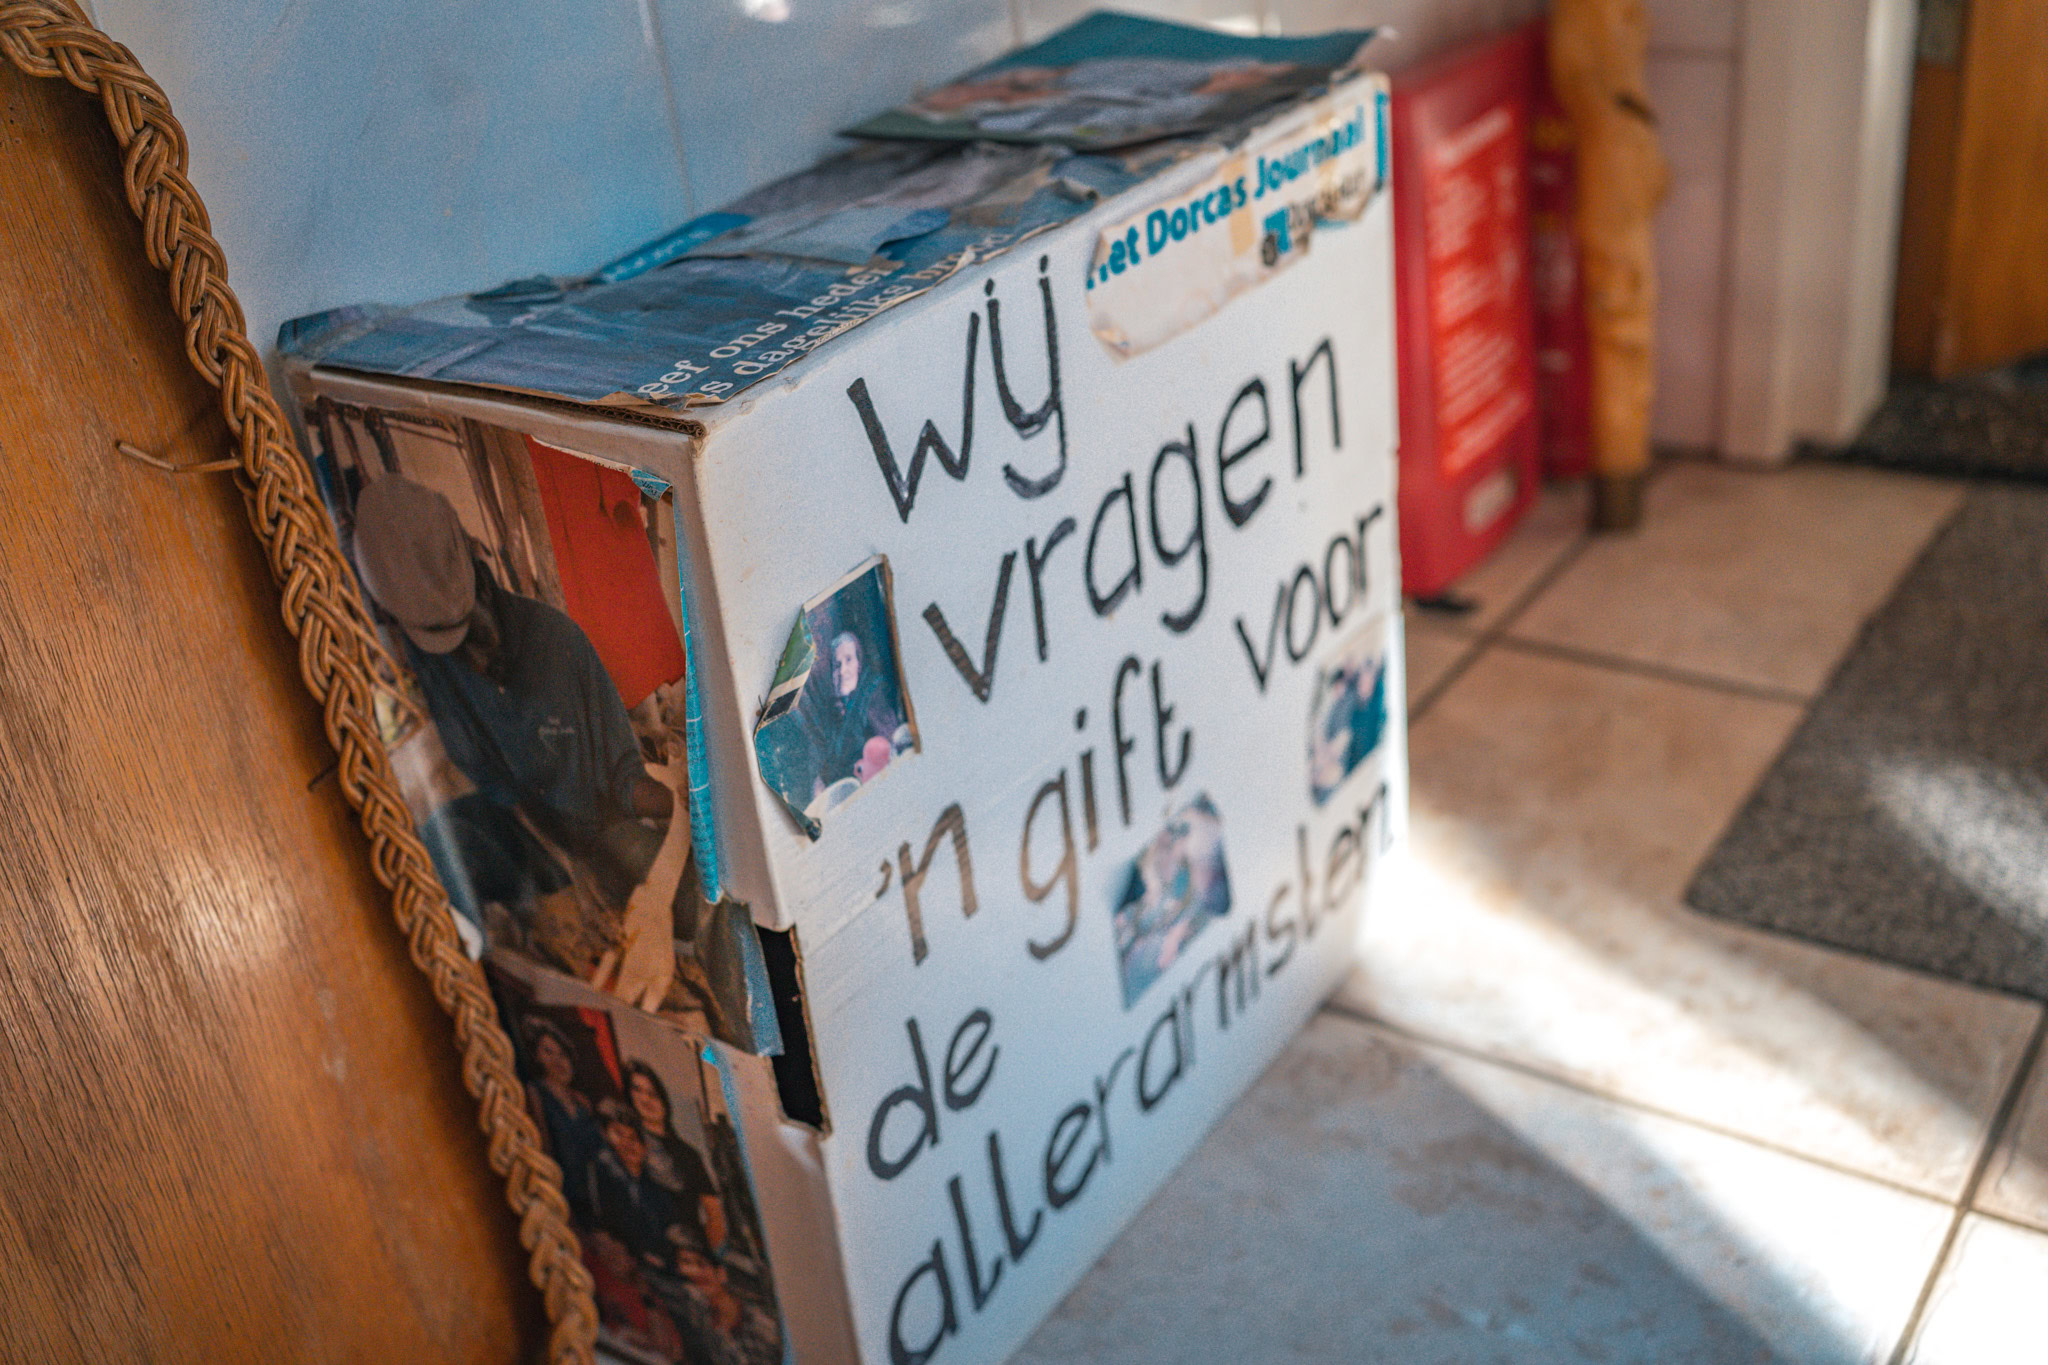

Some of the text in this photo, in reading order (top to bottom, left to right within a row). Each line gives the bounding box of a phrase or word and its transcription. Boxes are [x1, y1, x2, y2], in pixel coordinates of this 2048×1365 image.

[1086, 226, 1139, 290] et
[1147, 176, 1247, 256] Dorcas
[638, 359, 710, 397] eef
[709, 321, 788, 359] ons
[922, 337, 1341, 704] vragen
[1020, 654, 1192, 962] gift
[1235, 505, 1384, 695] voor
[866, 1008, 1001, 1181] de
